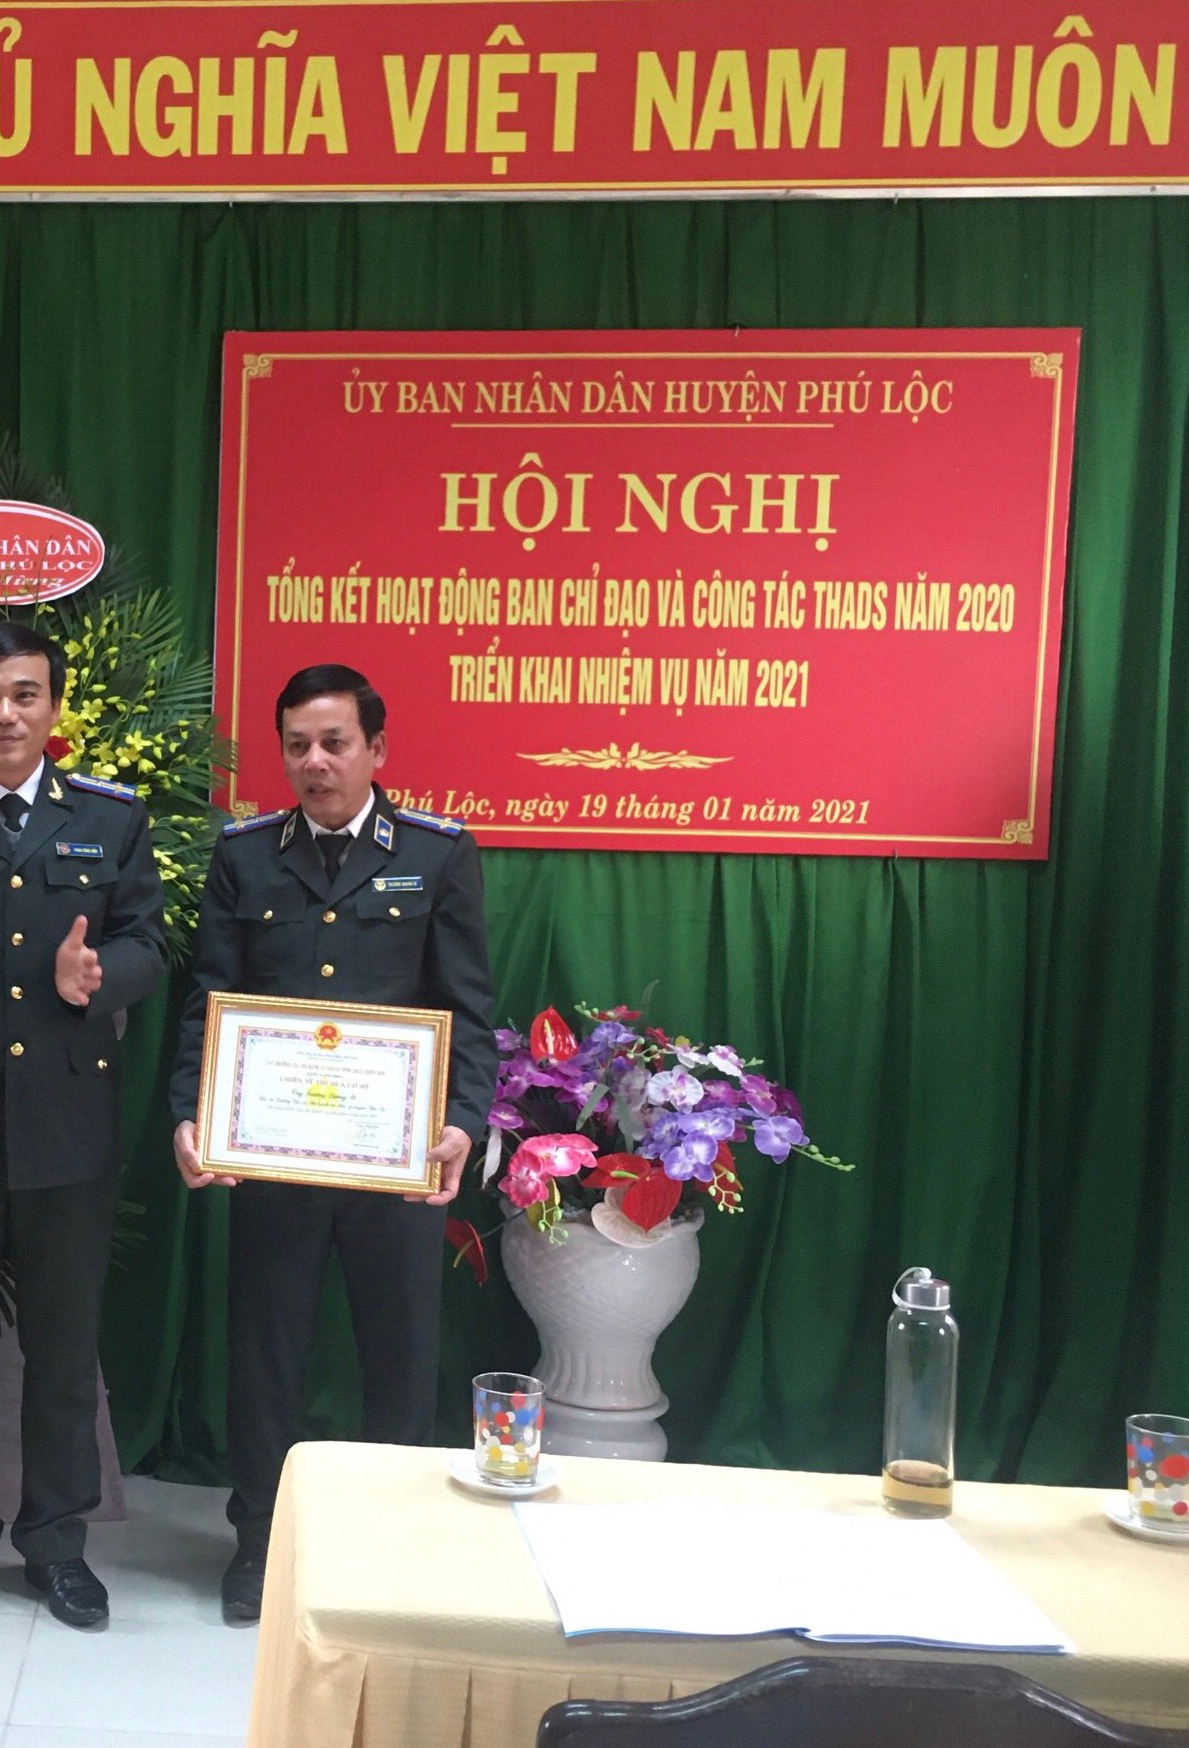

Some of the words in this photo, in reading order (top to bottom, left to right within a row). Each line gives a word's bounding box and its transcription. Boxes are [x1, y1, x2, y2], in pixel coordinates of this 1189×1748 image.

[75, 29, 348, 157] NGHĨA
[384, 24, 597, 174] VIỆT
[632, 47, 847, 151] NAM
[881, 15, 1177, 149] MUÔN
[343, 367, 389, 414] ỦY
[396, 381, 466, 414] BAN
[474, 371, 573, 414] NHÂN
[582, 370, 654, 414] DÂN
[663, 370, 787, 423] HUYỆN
[795, 370, 873, 414] PHÚ
[880, 370, 954, 424] LỘC
[438, 452, 593, 551] HỘI
[615, 472, 841, 552] NGHỊ
[45, 534, 92, 556] DÂN
[267, 556, 325, 623] TỔNG
[330, 560, 371, 624] KẾT
[376, 576, 434, 635] HOẠT
[438, 567, 501, 636] ĐỘNG
[506, 578, 554, 626] BAN
[559, 562, 600, 627] CHỈ
[603, 578, 650, 638] ĐẠO
[657, 568, 686, 627] VÀ
[692, 569, 756, 629] CÔNG
[763, 570, 806, 630] TÁC
[813, 581, 888, 631] THADS
[894, 571, 951, 631] NĂM
[956, 583, 1015, 633] 2020
[449, 635, 514, 703] TRIỂN
[519, 656, 572, 704] KHAI
[578, 647, 653, 716] NHIỆM
[660, 658, 689, 716] VỤ
[694, 648, 749, 707] NĂM
[754, 660, 809, 708] 2021
[442, 790, 496, 820] Lộc,
[505, 793, 569, 823] ngày
[578, 794, 608, 818] 19
[615, 794, 695, 826] tháng
[703, 796, 733, 820] 01
[741, 798, 801, 823] năm
[809, 799, 870, 824] 2021
